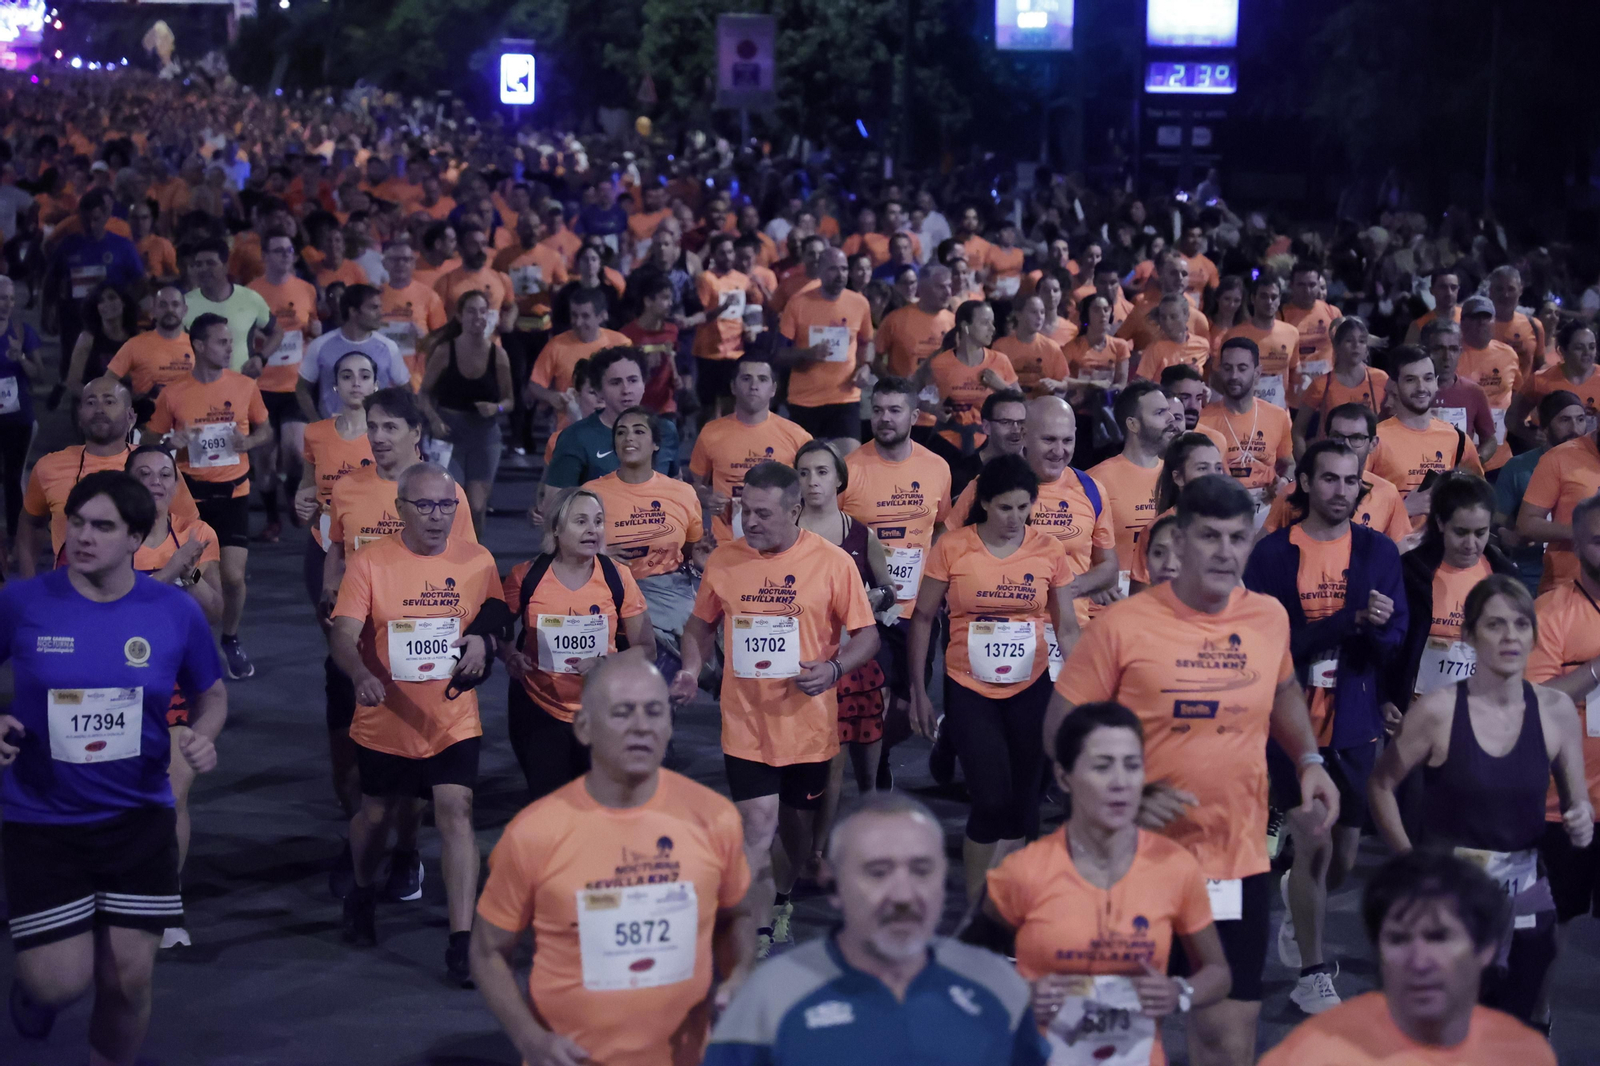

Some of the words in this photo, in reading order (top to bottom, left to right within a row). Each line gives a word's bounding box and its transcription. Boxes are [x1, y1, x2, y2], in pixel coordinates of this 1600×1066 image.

[202, 438, 226, 450] 2693
[876, 499, 906, 508] SEVILLA
[630, 511, 666, 519] NOCTURNA
[614, 519, 647, 528] SEVILLA
[648, 517, 666, 525] KH7
[1053, 519, 1073, 527] KH7
[360, 527, 392, 535] SEVILLA
[758, 588, 797, 596] NOCTURNA
[995, 584, 1037, 593] NOCTURNA
[420, 591, 460, 599] NOCTURNA
[740, 594, 775, 603] SEVILLA
[775, 595, 796, 604] KH7
[976, 590, 1014, 599] SEVILLA
[1016, 592, 1036, 602] KH7
[403, 599, 438, 607] SEVILLA
[439, 599, 460, 607] KH7
[406, 639, 449, 656] 10806
[554, 635, 596, 650] 10803
[745, 637, 786, 653] 13702
[984, 643, 1025, 657] 13725
[1198, 652, 1247, 660] NOCTURNA
[1176, 659, 1220, 669] SEVILLA
[1222, 660, 1246, 669] KH7
[1438, 660, 1477, 676] 17718
[71, 712, 125, 732] 17394
[615, 919, 670, 946] 5872
